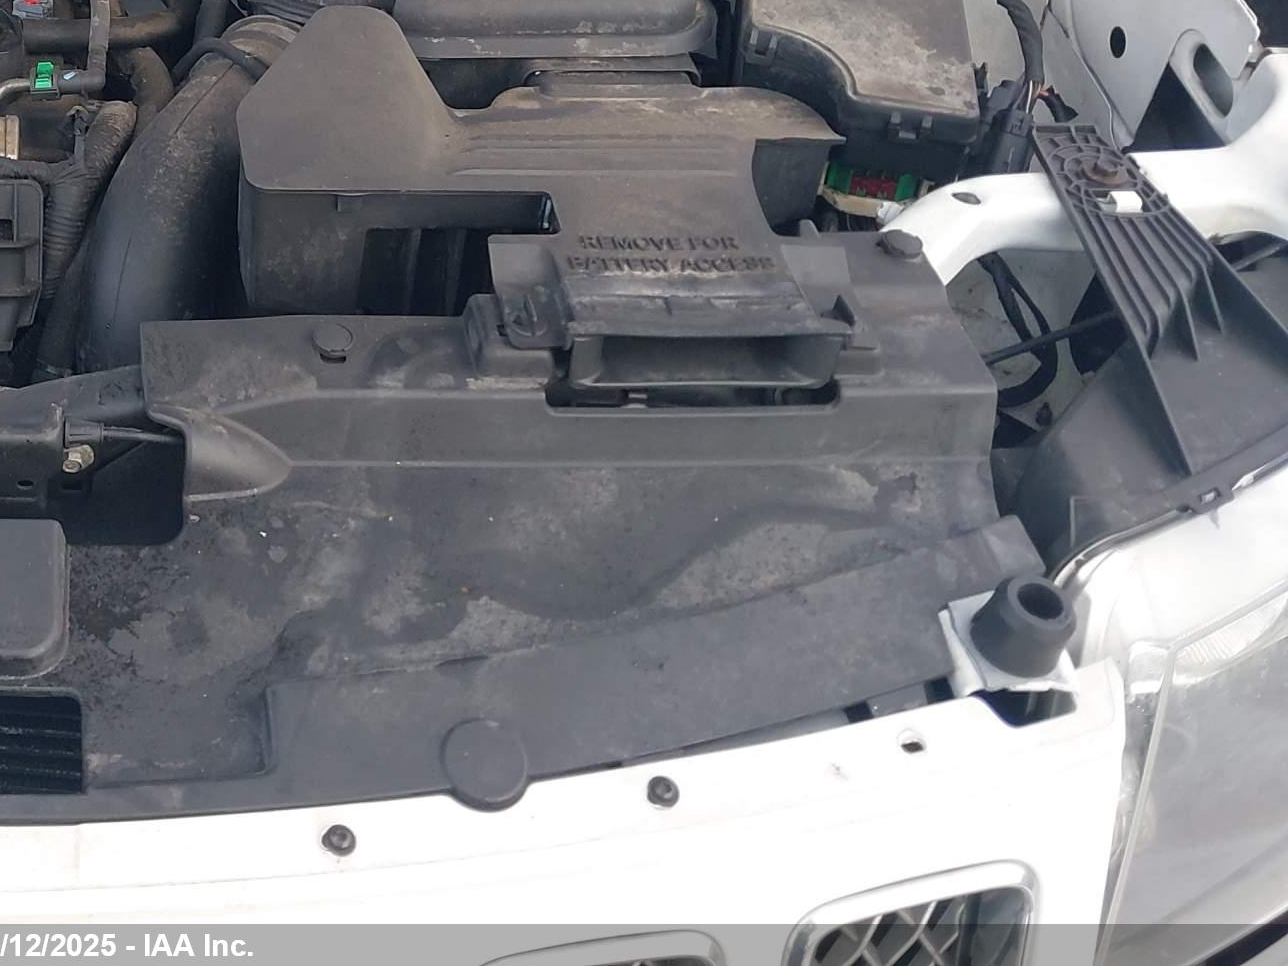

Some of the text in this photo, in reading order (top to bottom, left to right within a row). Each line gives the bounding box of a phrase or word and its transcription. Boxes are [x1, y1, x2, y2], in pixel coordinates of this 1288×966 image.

[578, 234, 740, 251] REMOVE FOR
[566, 256, 776, 273] BATTERY ACCESS
